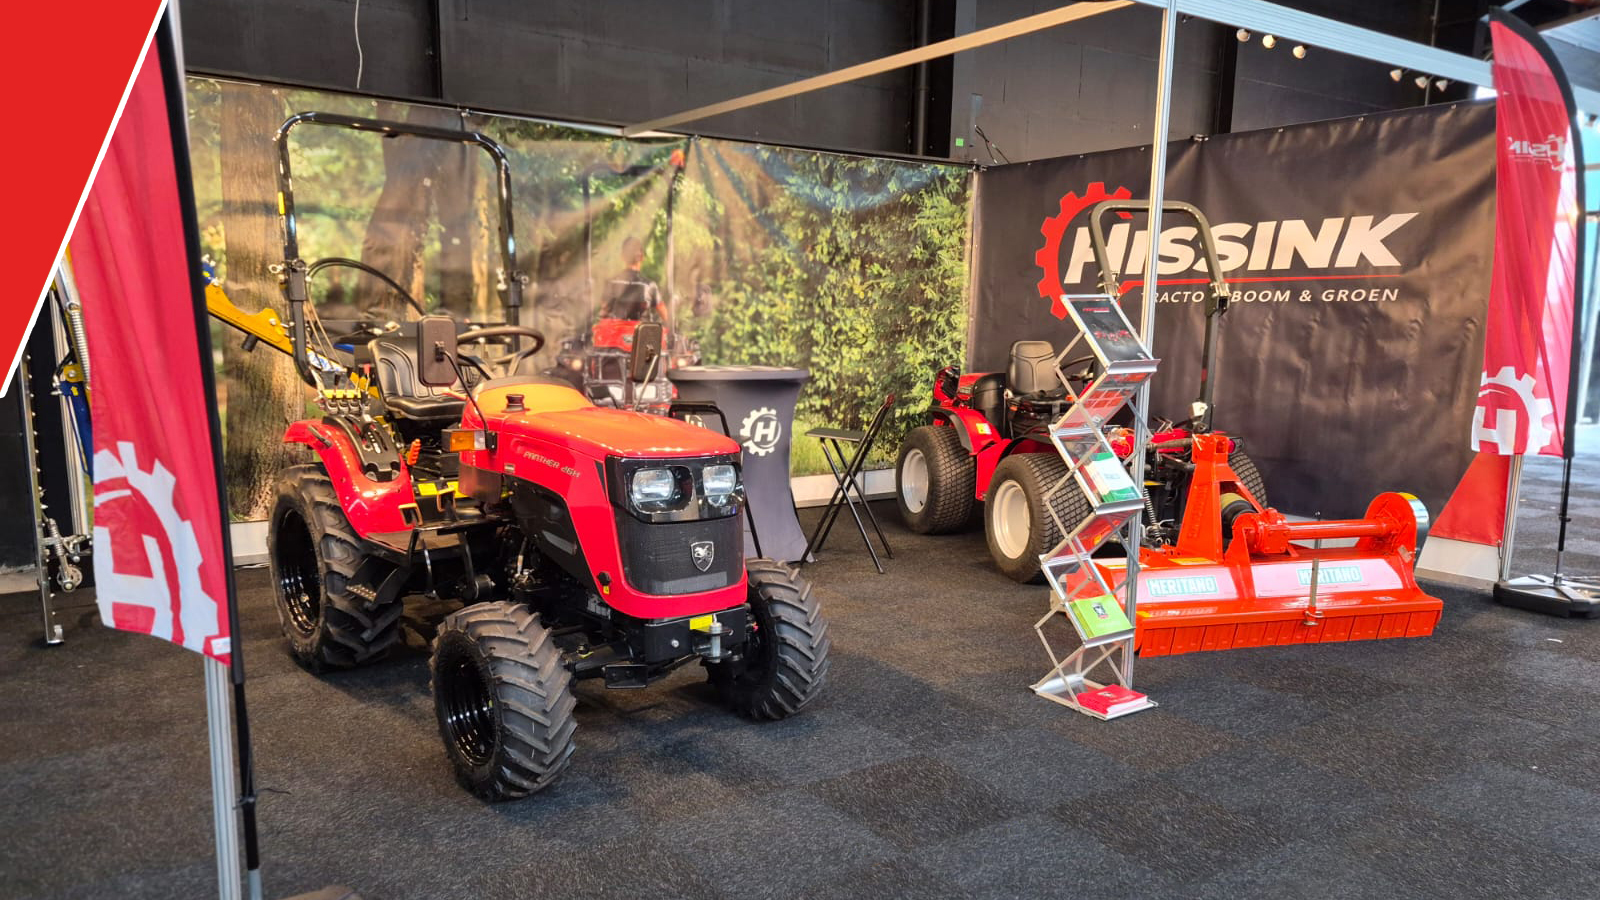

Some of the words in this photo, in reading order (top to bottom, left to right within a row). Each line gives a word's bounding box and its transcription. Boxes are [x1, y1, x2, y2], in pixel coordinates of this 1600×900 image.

[1064, 212, 1420, 284] HISSINK
[1230, 290, 1291, 302] BOOM
[1299, 289, 1312, 302] &
[1321, 288, 1399, 302] GROEN
[523, 451, 560, 469] PANTHER
[1149, 578, 1215, 595] MERITANO
